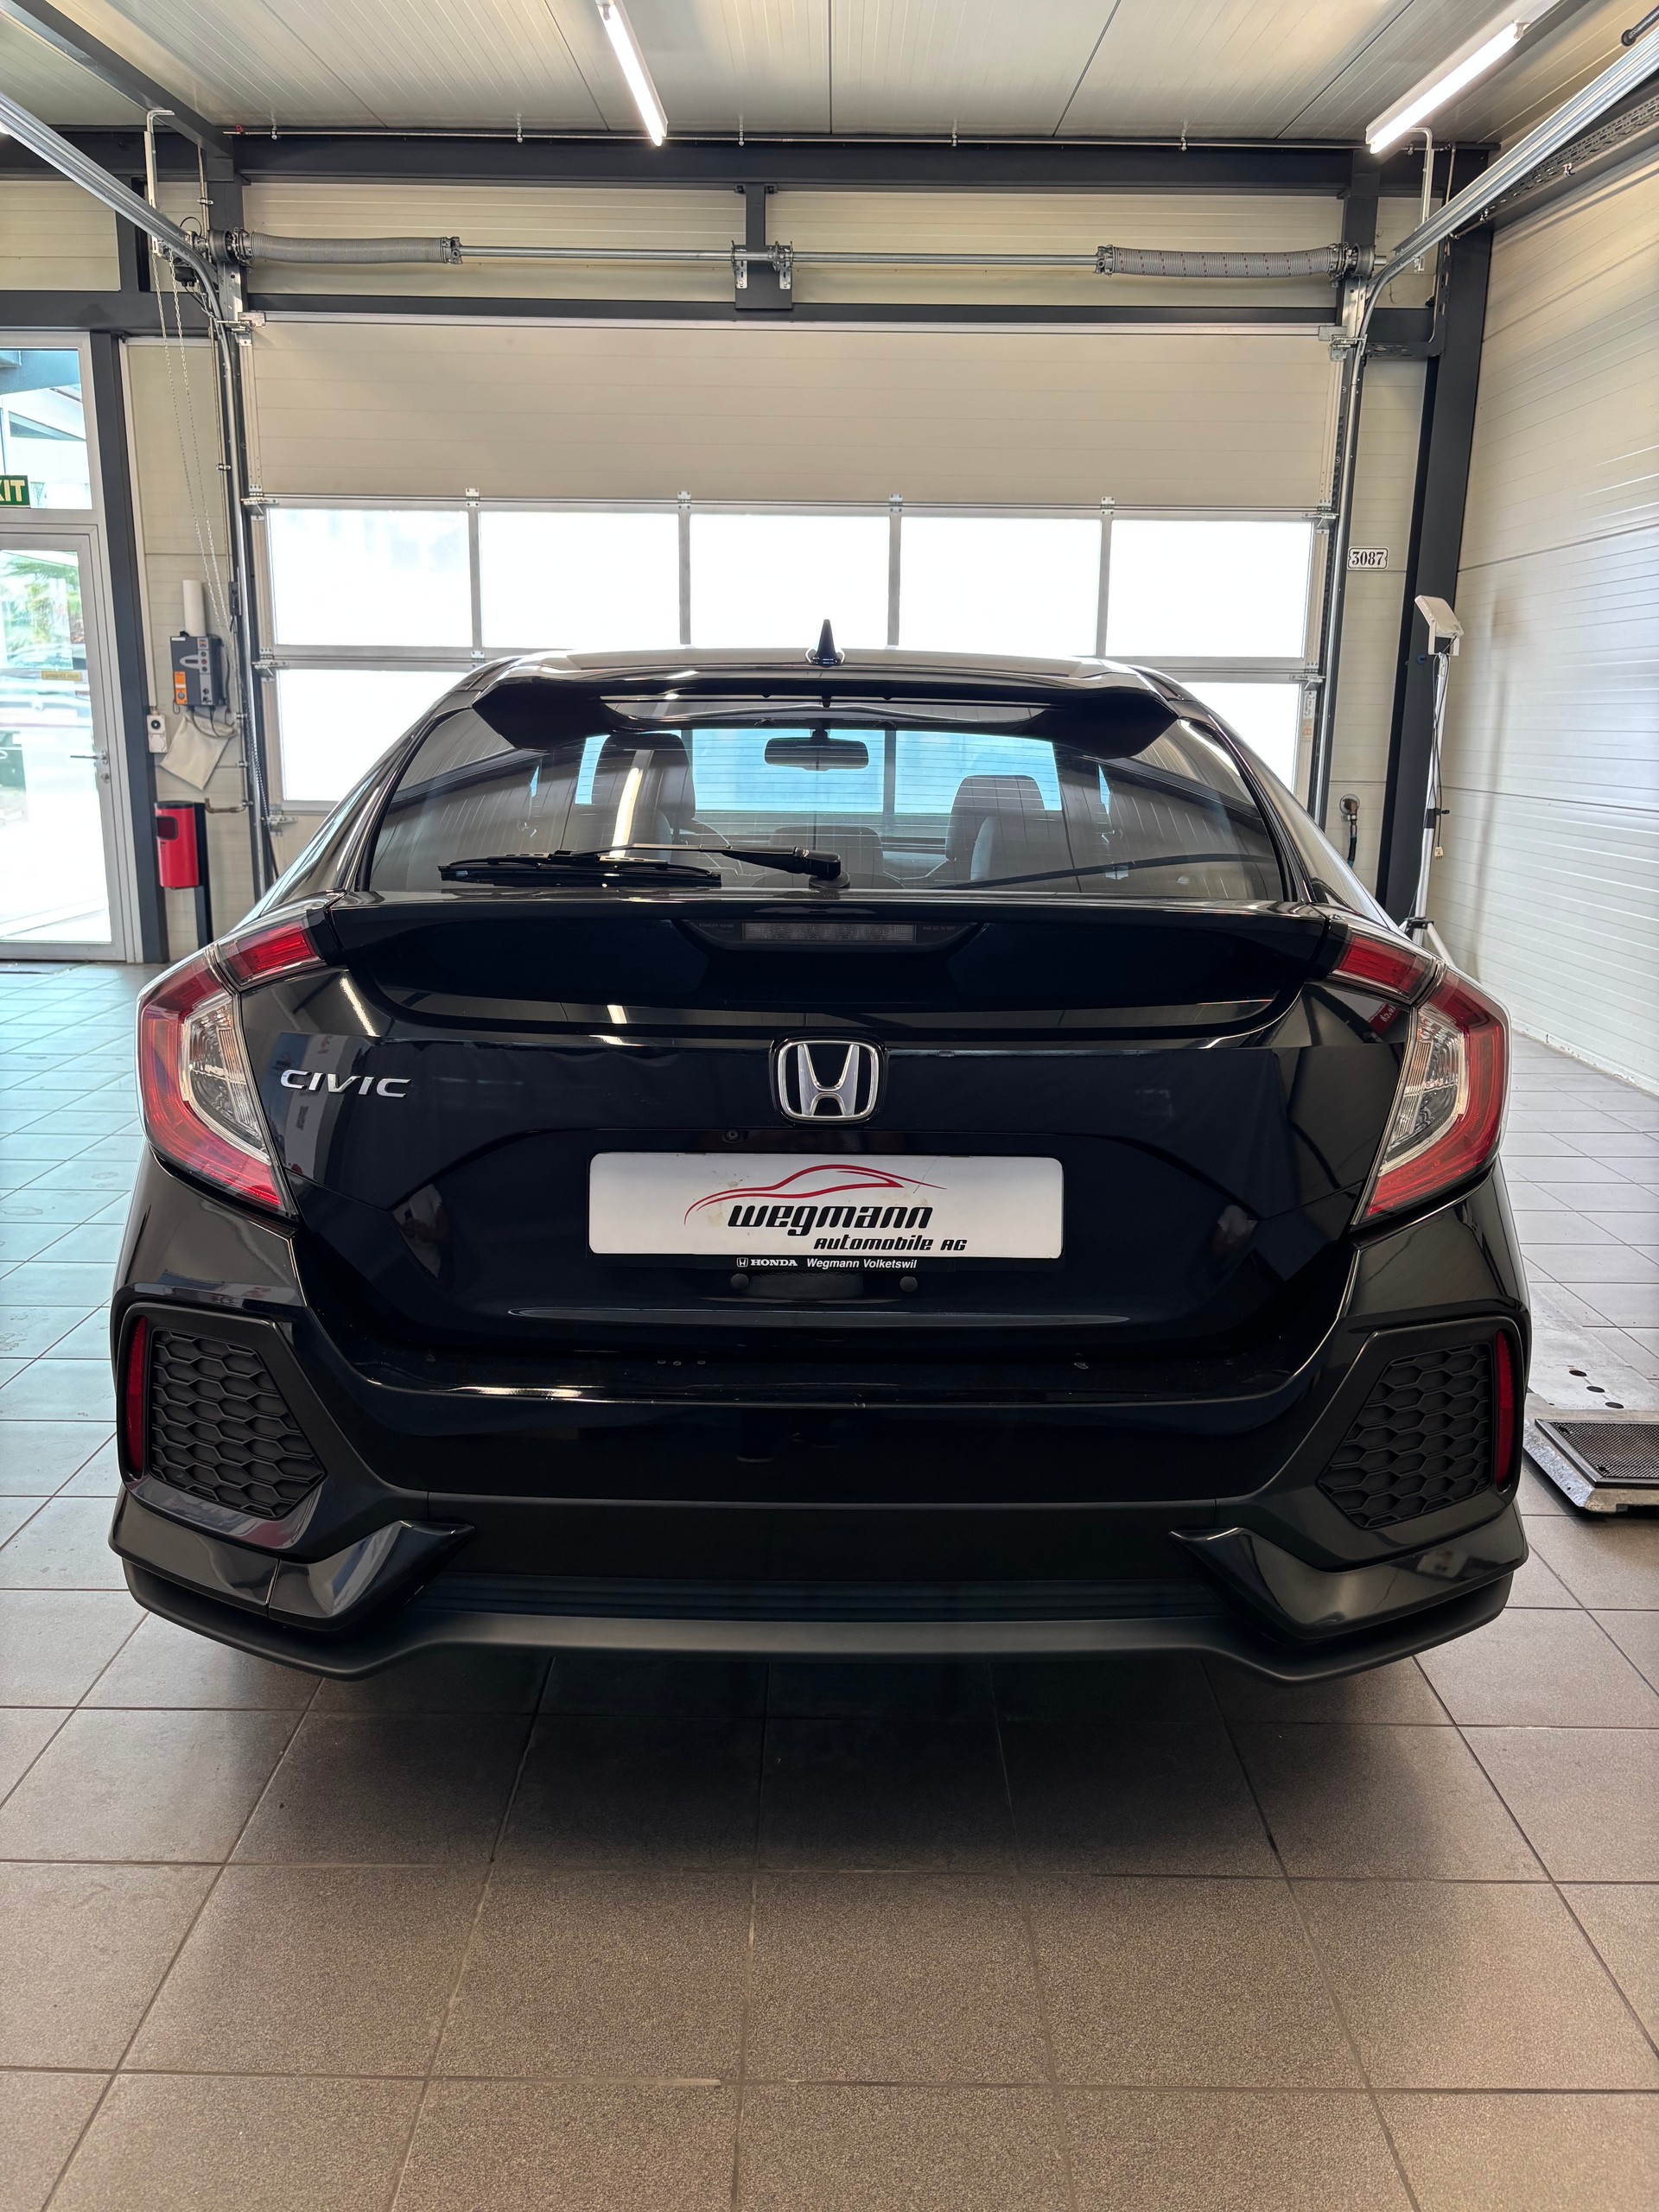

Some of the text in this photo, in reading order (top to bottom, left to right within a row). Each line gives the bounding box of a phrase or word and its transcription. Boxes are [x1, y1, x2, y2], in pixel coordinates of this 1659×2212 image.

[0, 480, 25, 501] IT
[1351, 551, 1384, 566] 3087
[281, 1070, 410, 1097] CIVIC
[728, 1205, 933, 1236] wegmann
[940, 1239, 968, 1251] AG
[806, 1258, 860, 1270] Wegmann
[863, 1258, 918, 1269] Volketswil
